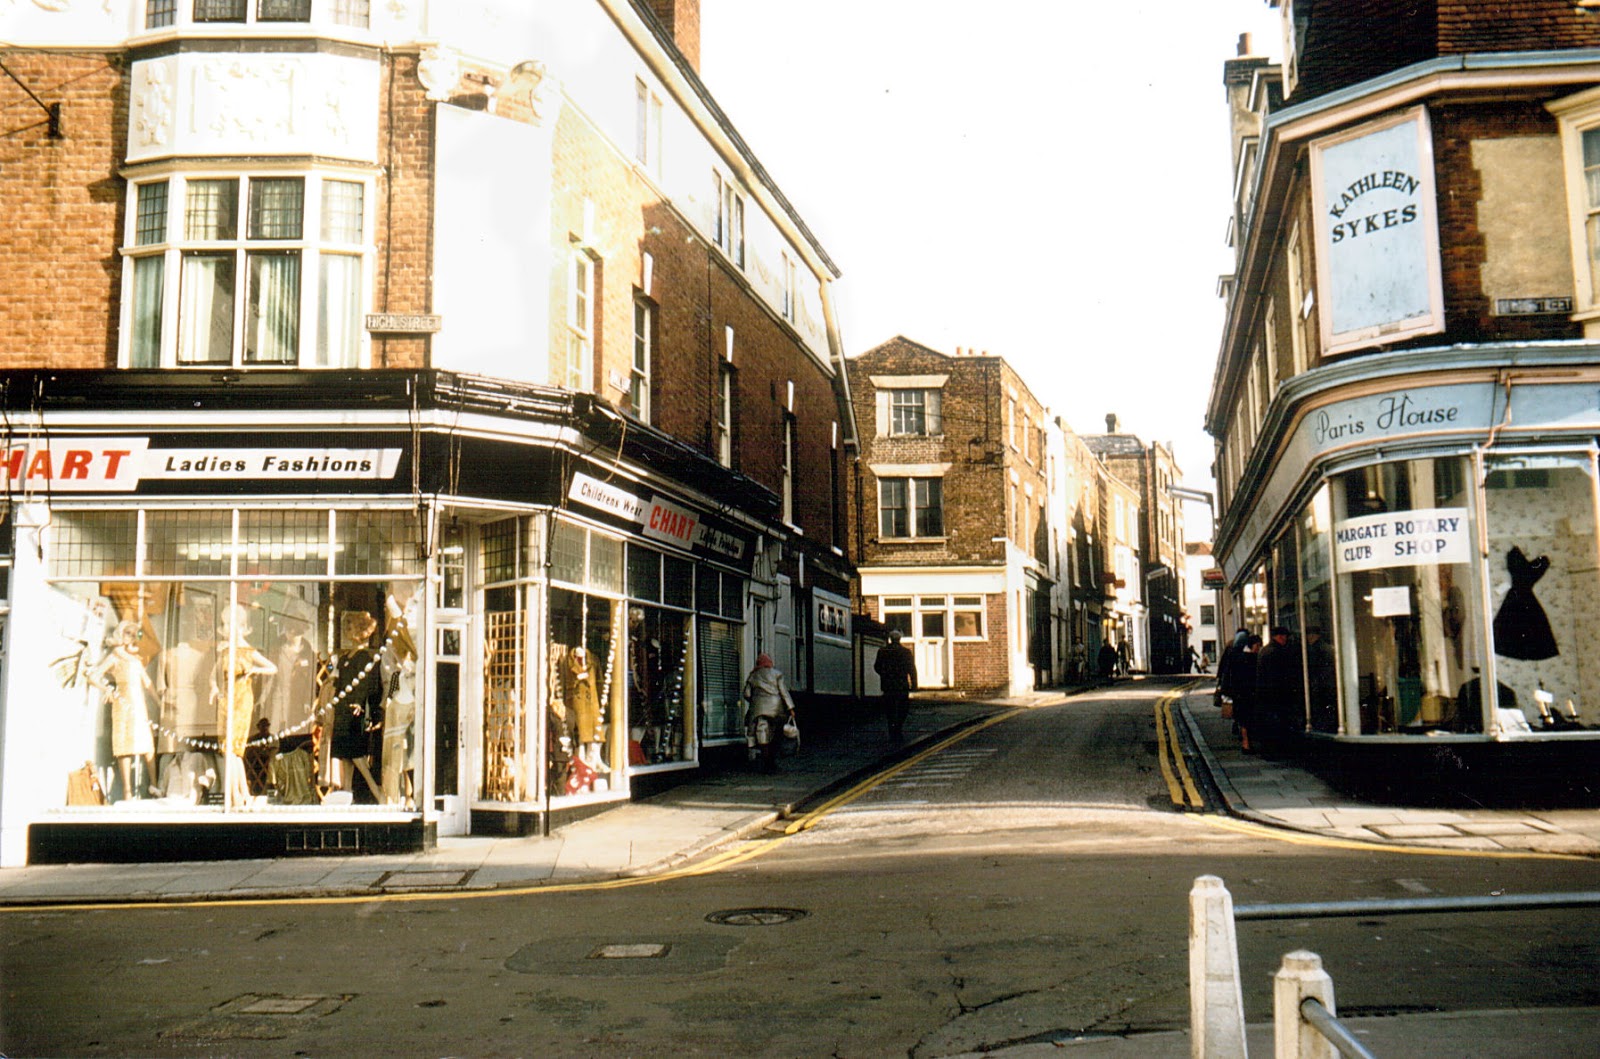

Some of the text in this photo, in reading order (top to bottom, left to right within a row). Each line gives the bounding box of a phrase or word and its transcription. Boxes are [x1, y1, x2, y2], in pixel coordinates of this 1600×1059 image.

[1329, 171, 1420, 219] KATHLEEN
[1332, 204, 1417, 243] SYKES
[367, 315, 439, 329] HIGH STREET
[1315, 393, 1458, 444] Paris House
[165, 456, 246, 472] Ladies
[262, 456, 371, 472] Fashions
[581, 483, 642, 517] Childrens Wear
[649, 505, 696, 541] CHART
[1336, 518, 1459, 544] MARGATE ROTARY
[1344, 539, 1446, 562] CLUB SHOP
